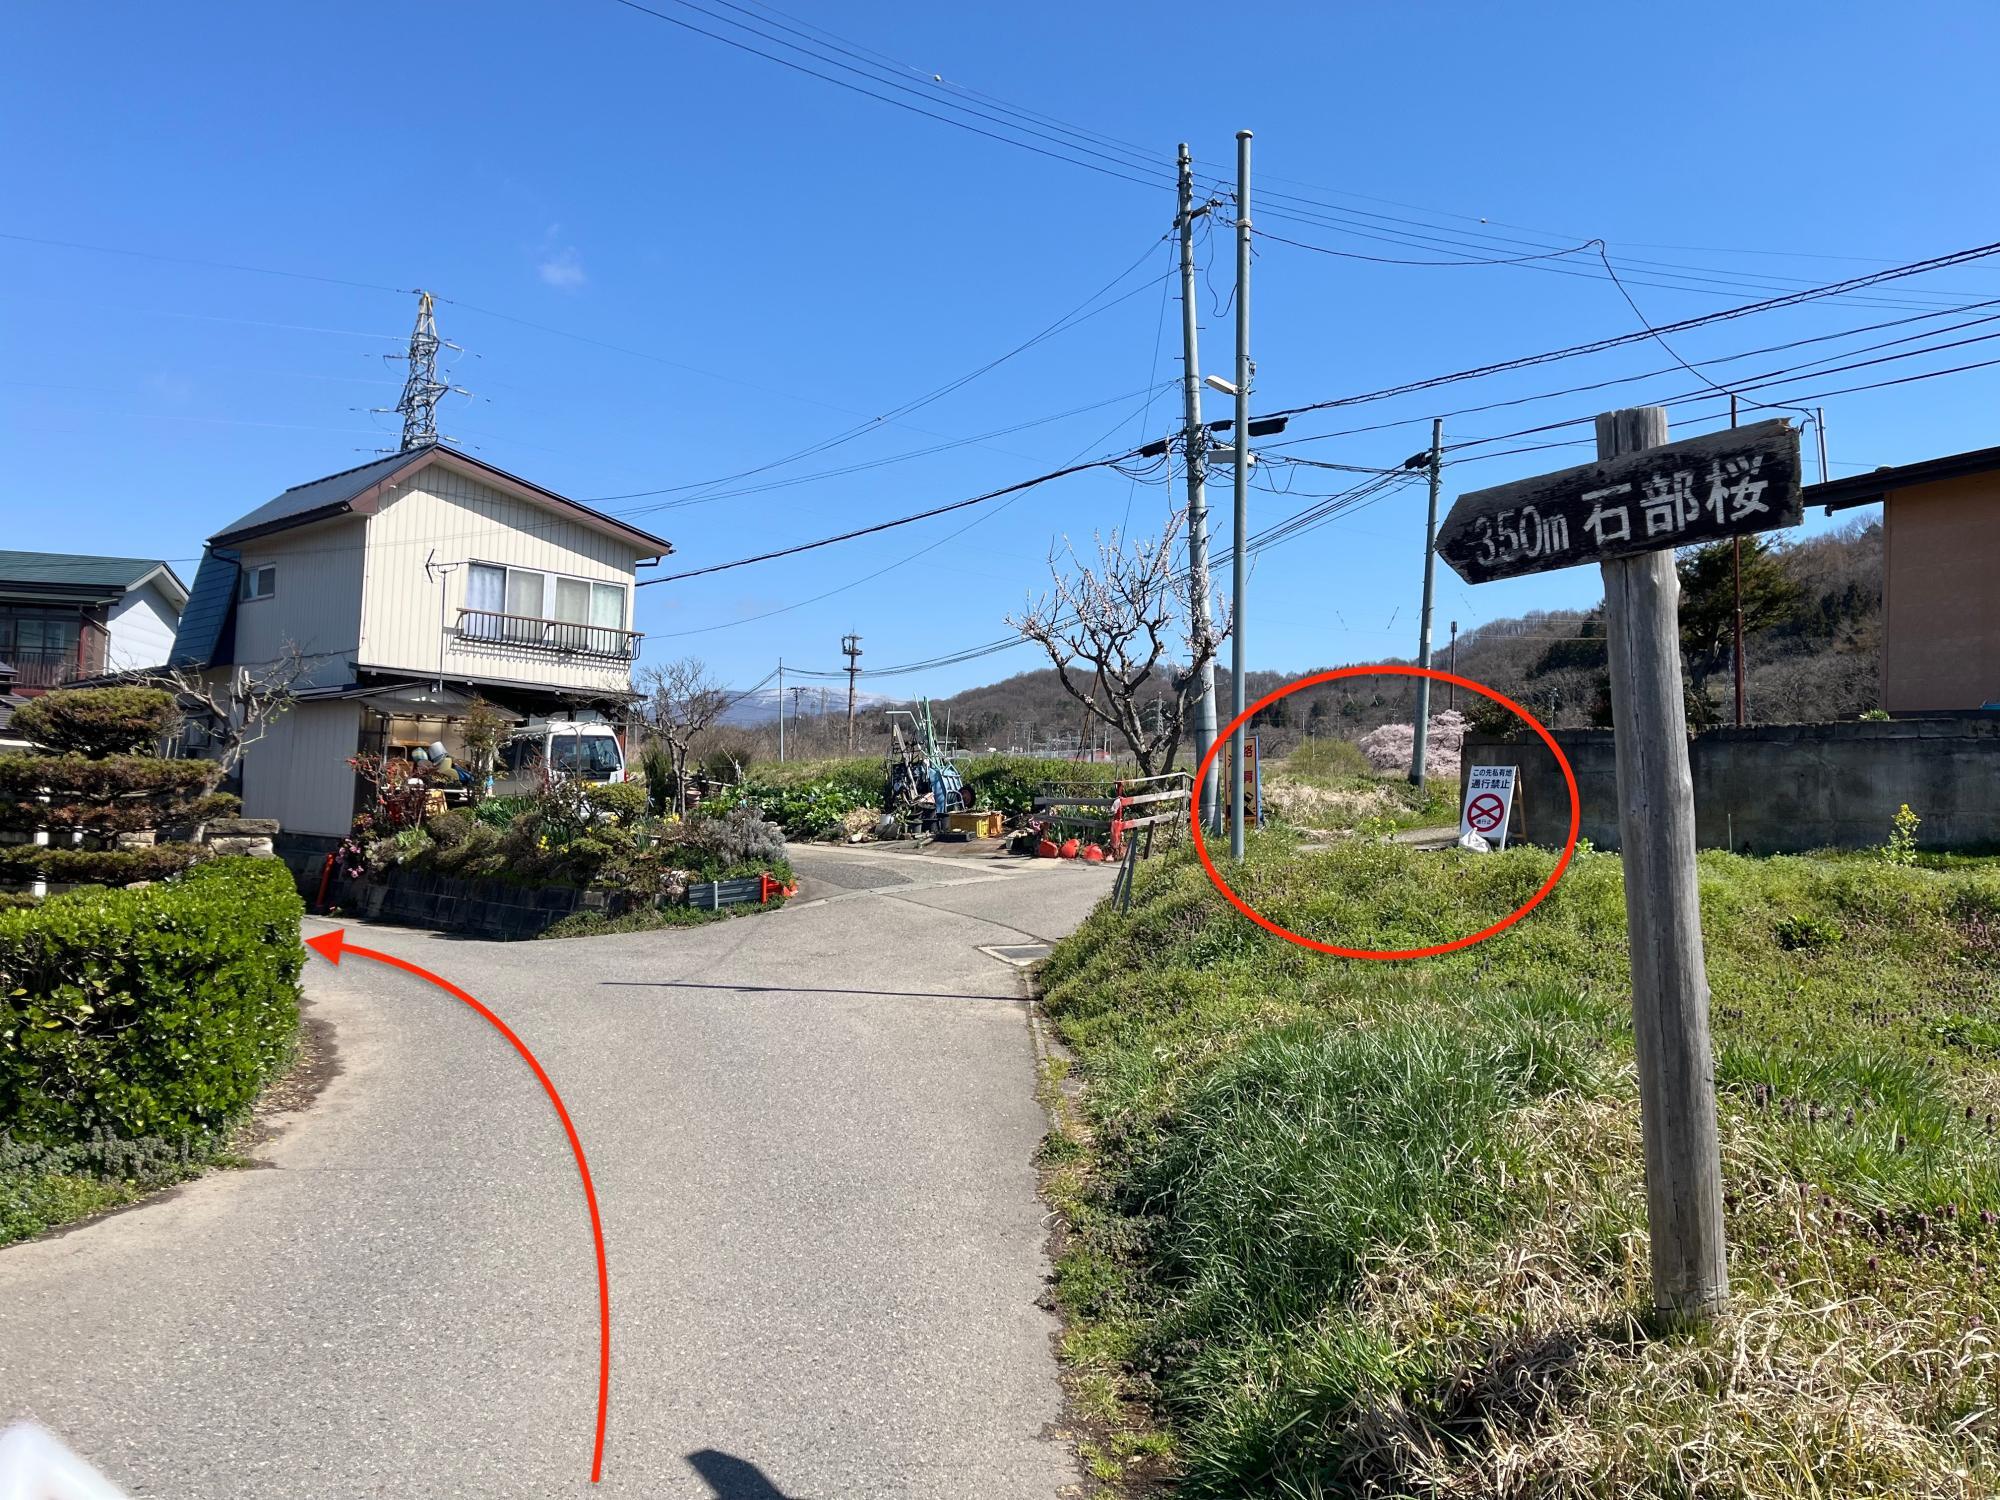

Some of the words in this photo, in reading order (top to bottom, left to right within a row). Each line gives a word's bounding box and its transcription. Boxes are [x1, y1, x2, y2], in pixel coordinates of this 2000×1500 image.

[1474, 505, 1570, 568] 350m
[1581, 455, 1770, 546] 石部桜
[1473, 769, 1512, 777] この先私有地
[1471, 779, 1510, 789] 通行禁止
